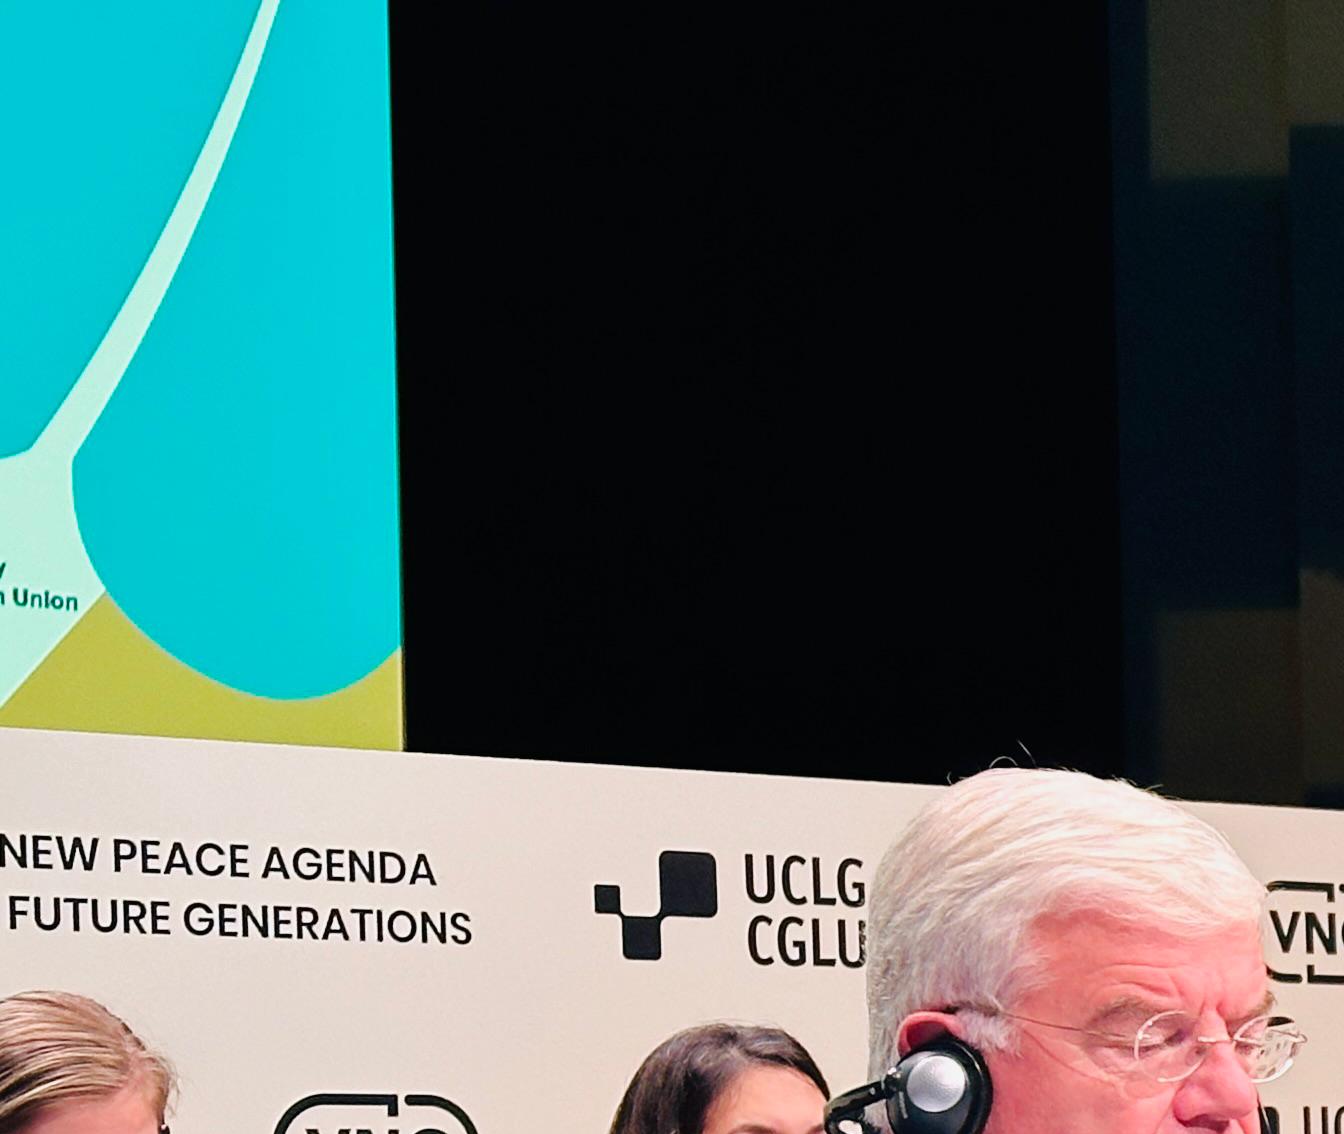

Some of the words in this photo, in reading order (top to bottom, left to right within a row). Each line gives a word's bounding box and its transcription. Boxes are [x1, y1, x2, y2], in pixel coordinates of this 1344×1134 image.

[13, 587, 78, 611] Union
[0, 833, 99, 871] NEW
[114, 839, 249, 877] PEACE
[262, 847, 437, 885] AGENDA
[745, 854, 865, 907] UCLG
[9, 896, 170, 934] FUTURE
[184, 903, 471, 944] GENERATIONS
[748, 915, 866, 968] CGLU
